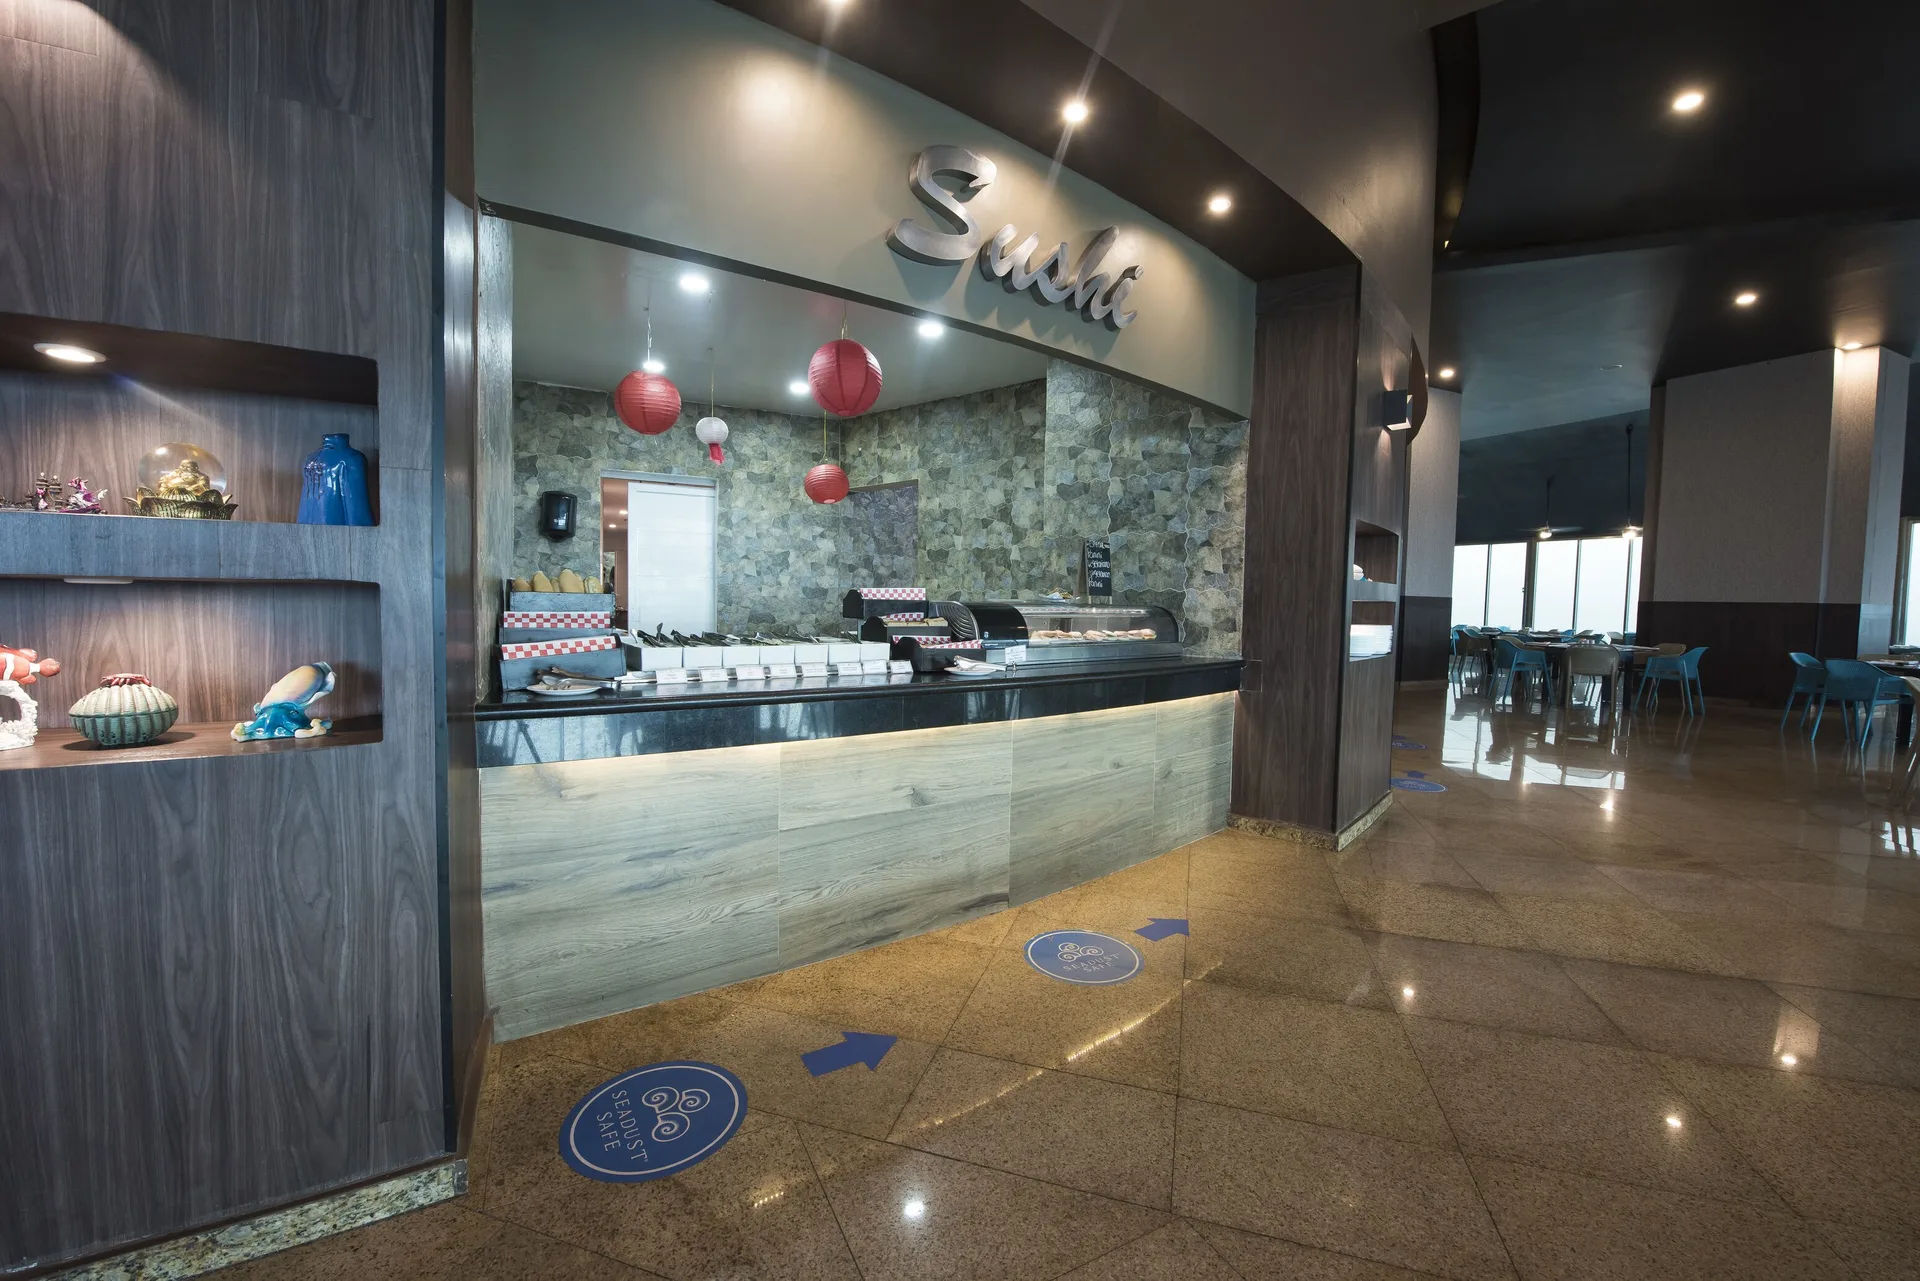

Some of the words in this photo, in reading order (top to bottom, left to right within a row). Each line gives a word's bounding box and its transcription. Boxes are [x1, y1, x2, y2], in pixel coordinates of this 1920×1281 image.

[886, 145, 1144, 331] Sushi
[1063, 953, 1119, 971] SEADUST
[1083, 961, 1113, 973] SAFE
[596, 1111, 621, 1152] SAFE
